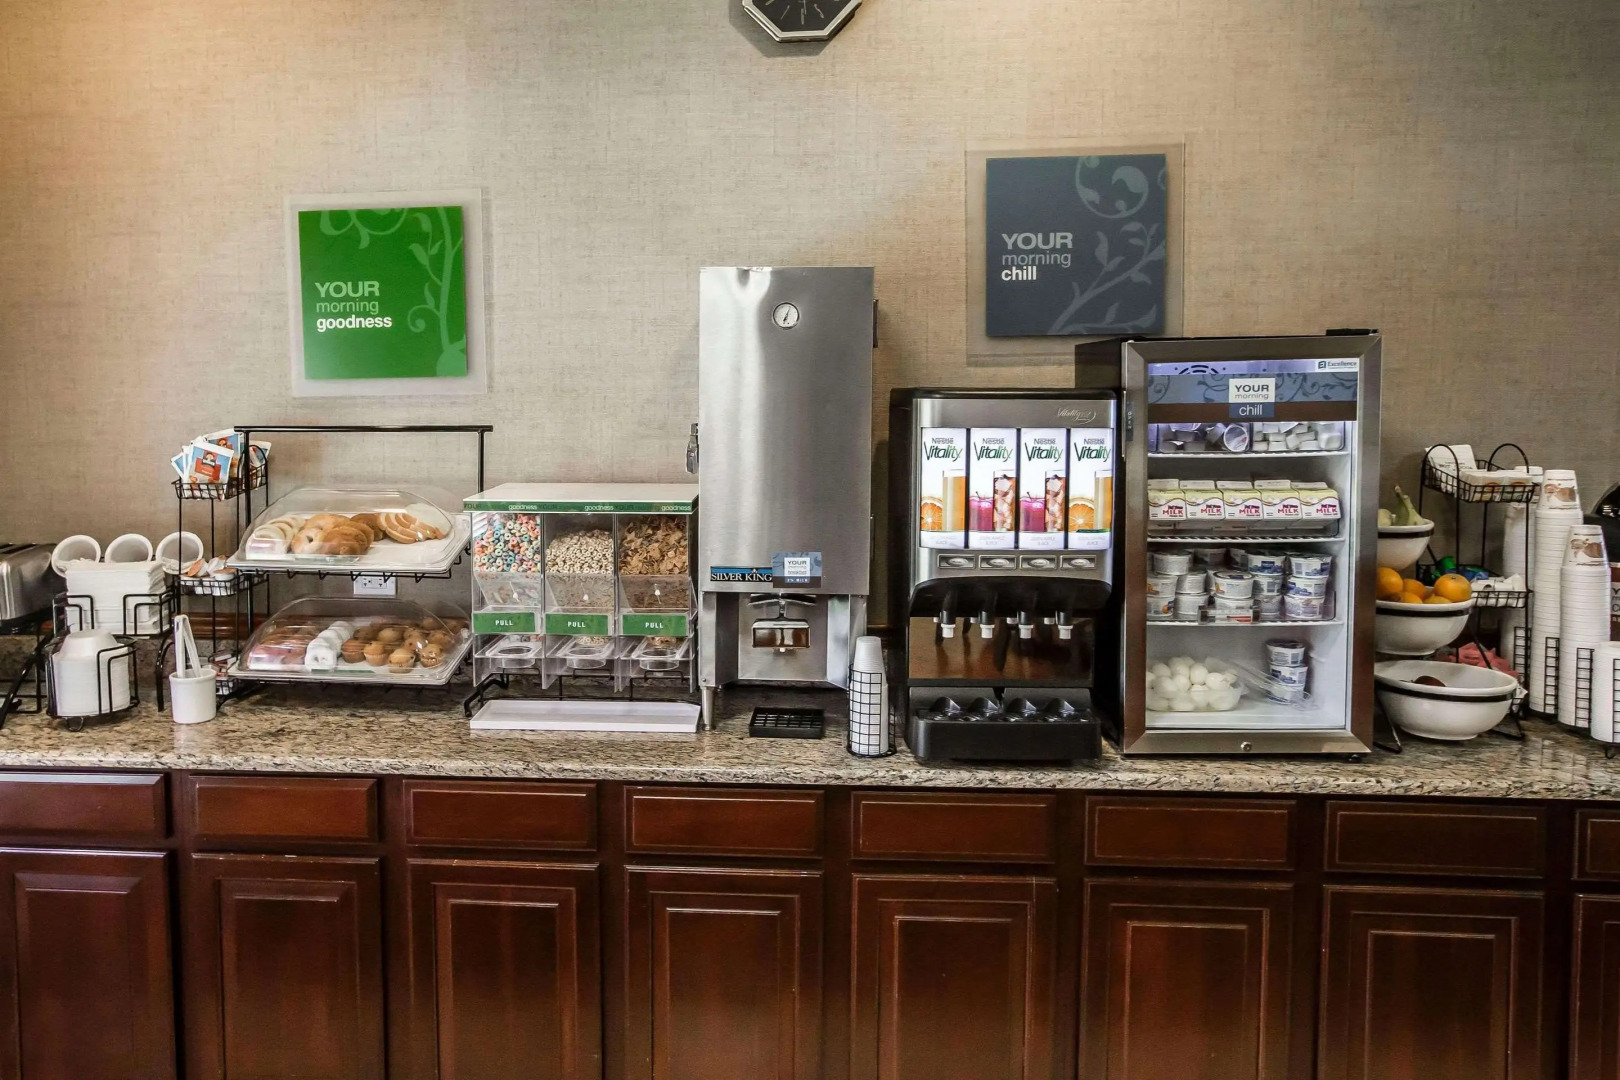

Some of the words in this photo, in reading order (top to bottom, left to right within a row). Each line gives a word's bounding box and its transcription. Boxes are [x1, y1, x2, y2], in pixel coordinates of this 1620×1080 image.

[1001, 232, 1073, 250] YOUR
[1002, 250, 1071, 268] morning
[1001, 265, 1037, 281] chill
[314, 280, 380, 298] YOUR
[316, 298, 379, 315] morning
[316, 314, 393, 333] goodness
[1234, 384, 1270, 393] YOUR
[1234, 392, 1269, 400] morning
[1238, 404, 1263, 416] chill
[923, 441, 963, 462] Vitality
[973, 441, 1013, 462] Vitality
[1024, 442, 1063, 462] Vitality
[1073, 442, 1111, 462] Vitality
[508, 503, 538, 511] goodness
[711, 572, 743, 581] SILVER
[745, 572, 773, 582] KING
[567, 620, 586, 628] PULL
